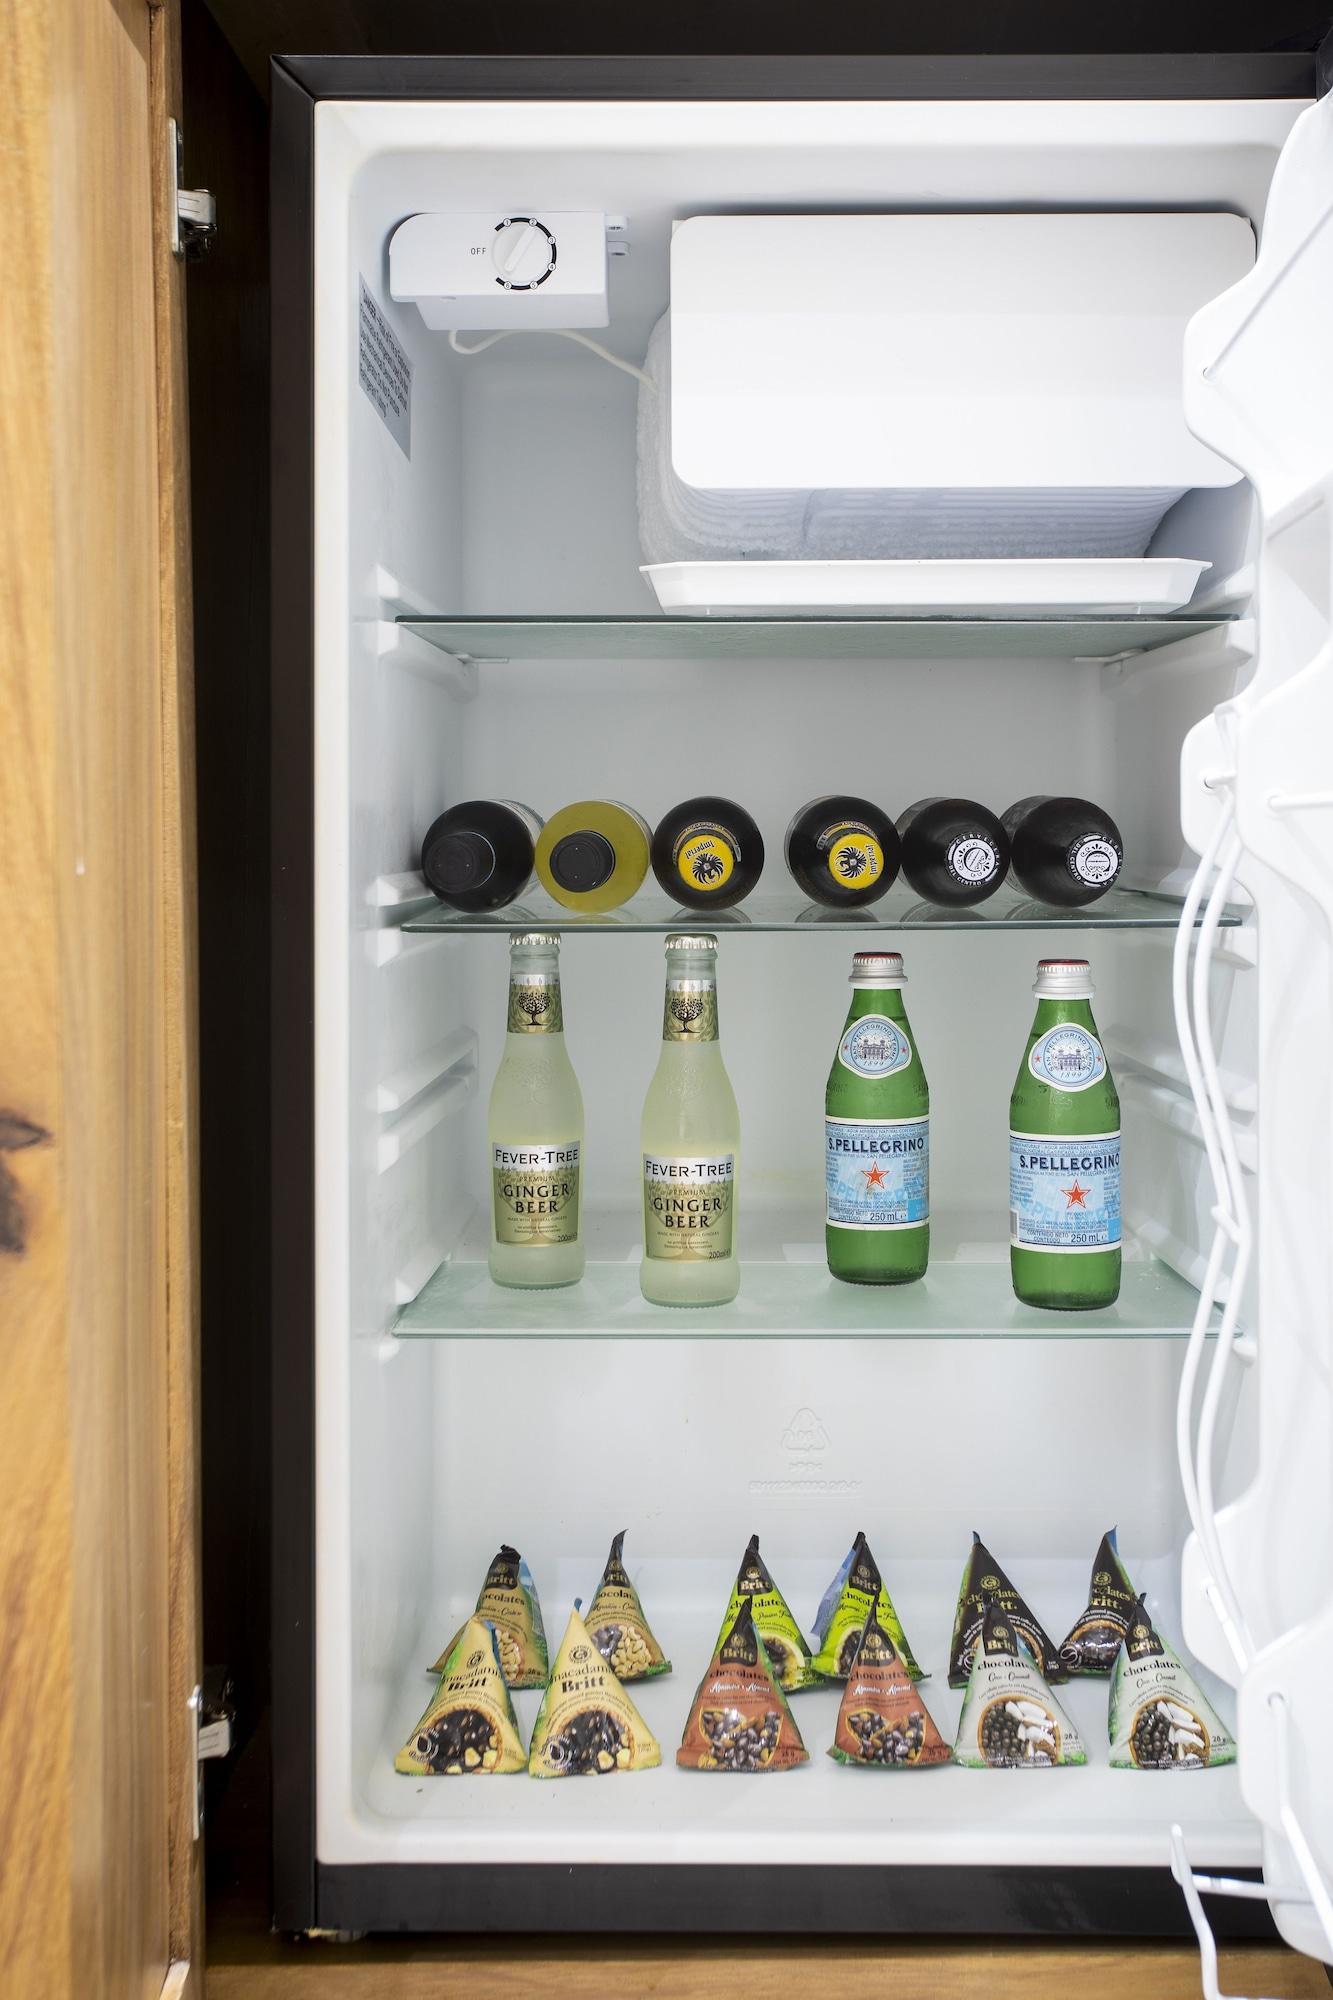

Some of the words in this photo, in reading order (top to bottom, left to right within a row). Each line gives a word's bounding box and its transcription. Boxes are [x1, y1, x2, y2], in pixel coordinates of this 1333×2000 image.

[470, 247, 487, 255] OFF
[684, 840, 715, 859] Imperial
[865, 844, 878, 876] Imperial
[828, 1137, 924, 1153] S.PELLEGRINO
[495, 1149, 578, 1164] FEVER-TREE
[1019, 1153, 1119, 1170] S.PELLEGRINO
[645, 1160, 732, 1176] FEVER-TREE
[503, 1184, 570, 1197] GINGER
[515, 1200, 559, 1213] BEER
[653, 1197, 722, 1212] GINGER
[665, 1215, 710, 1228] BEER
[870, 1212, 886, 1221] 250
[1071, 1234, 1087, 1242] 250
[841, 1591, 892, 1609] chocoltes
[723, 1647, 755, 1662] Britt
[860, 1648, 893, 1660] Britt
[977, 1658, 1035, 1672] chocolates
[1123, 1660, 1181, 1677] chocolates
[709, 1669, 770, 1681] chocolates
[850, 1671, 910, 1681] chocolates
[448, 1676, 487, 1691] Britt
[562, 1675, 605, 1693] Britt
